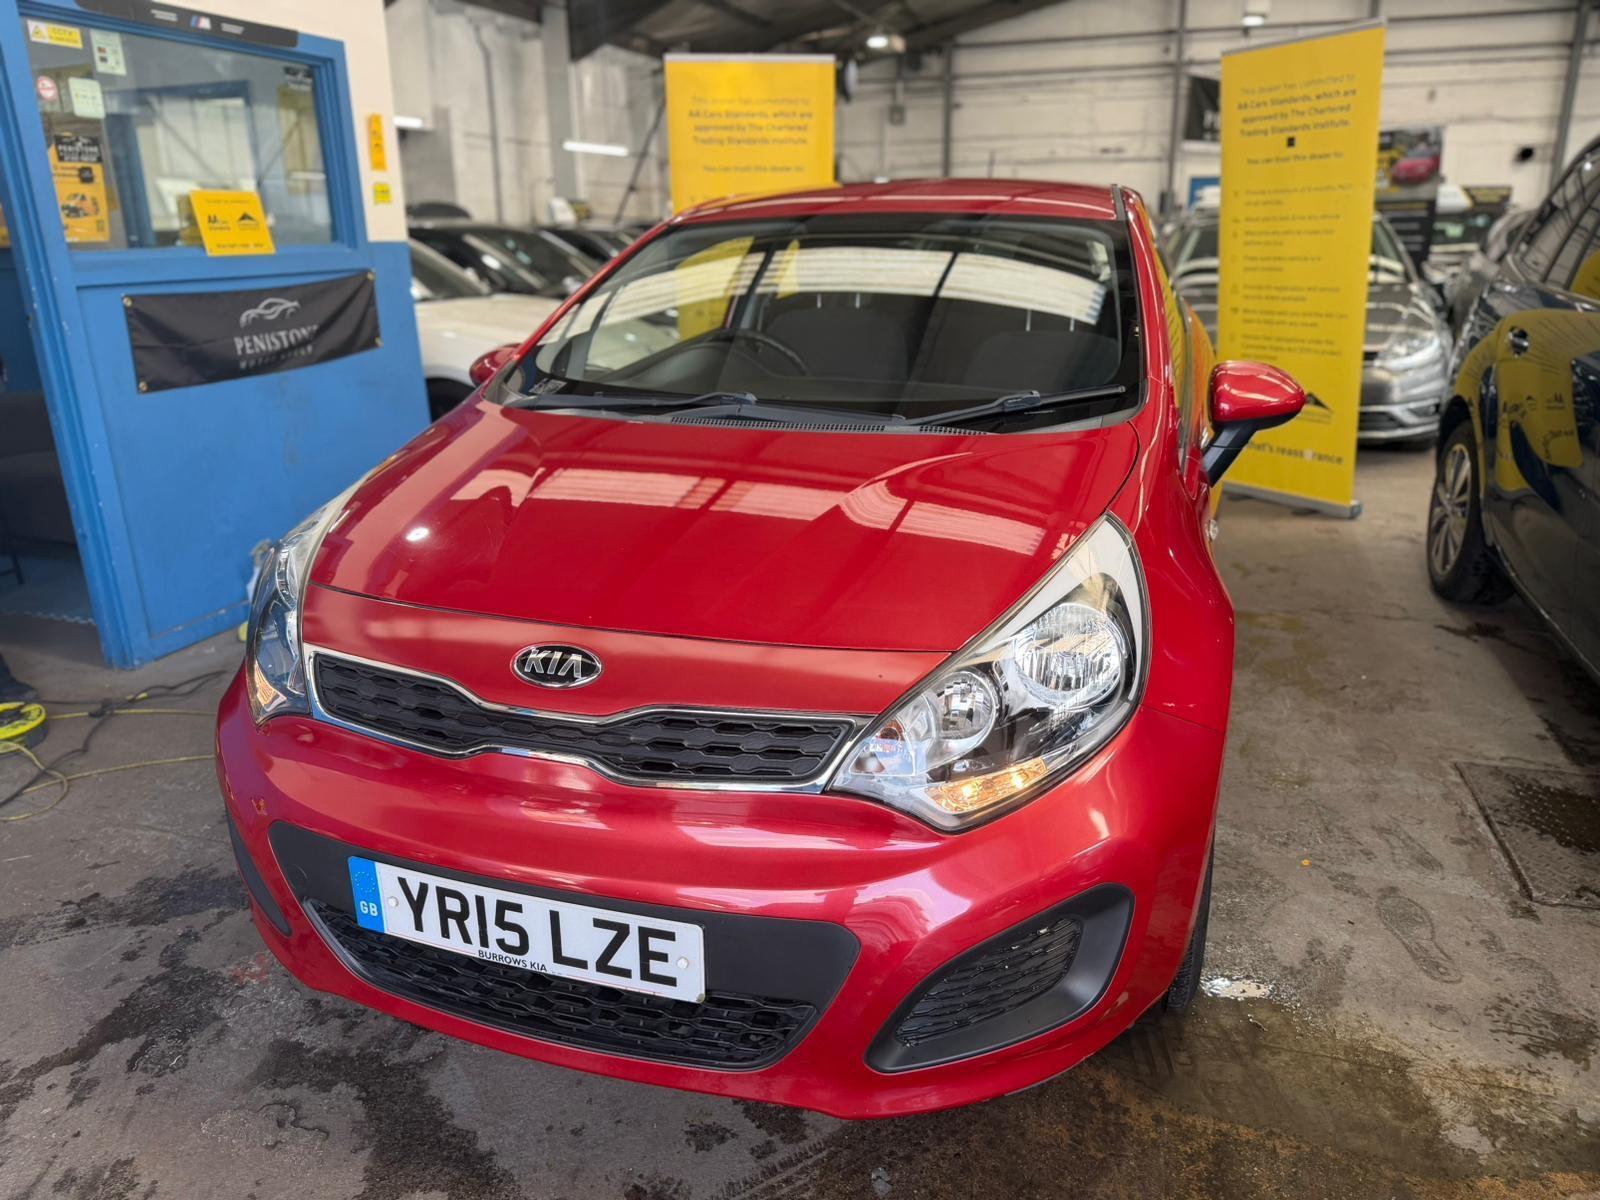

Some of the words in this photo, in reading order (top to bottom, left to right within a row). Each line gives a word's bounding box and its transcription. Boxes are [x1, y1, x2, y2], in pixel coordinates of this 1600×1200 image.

[233, 325, 319, 356] PENISTON
[524, 648, 582, 679] KIA
[359, 900, 378, 917] GB
[397, 876, 530, 956] YR15
[549, 909, 678, 987] LZE
[478, 949, 528, 968] BURROWS
[529, 961, 548, 972] KIA
